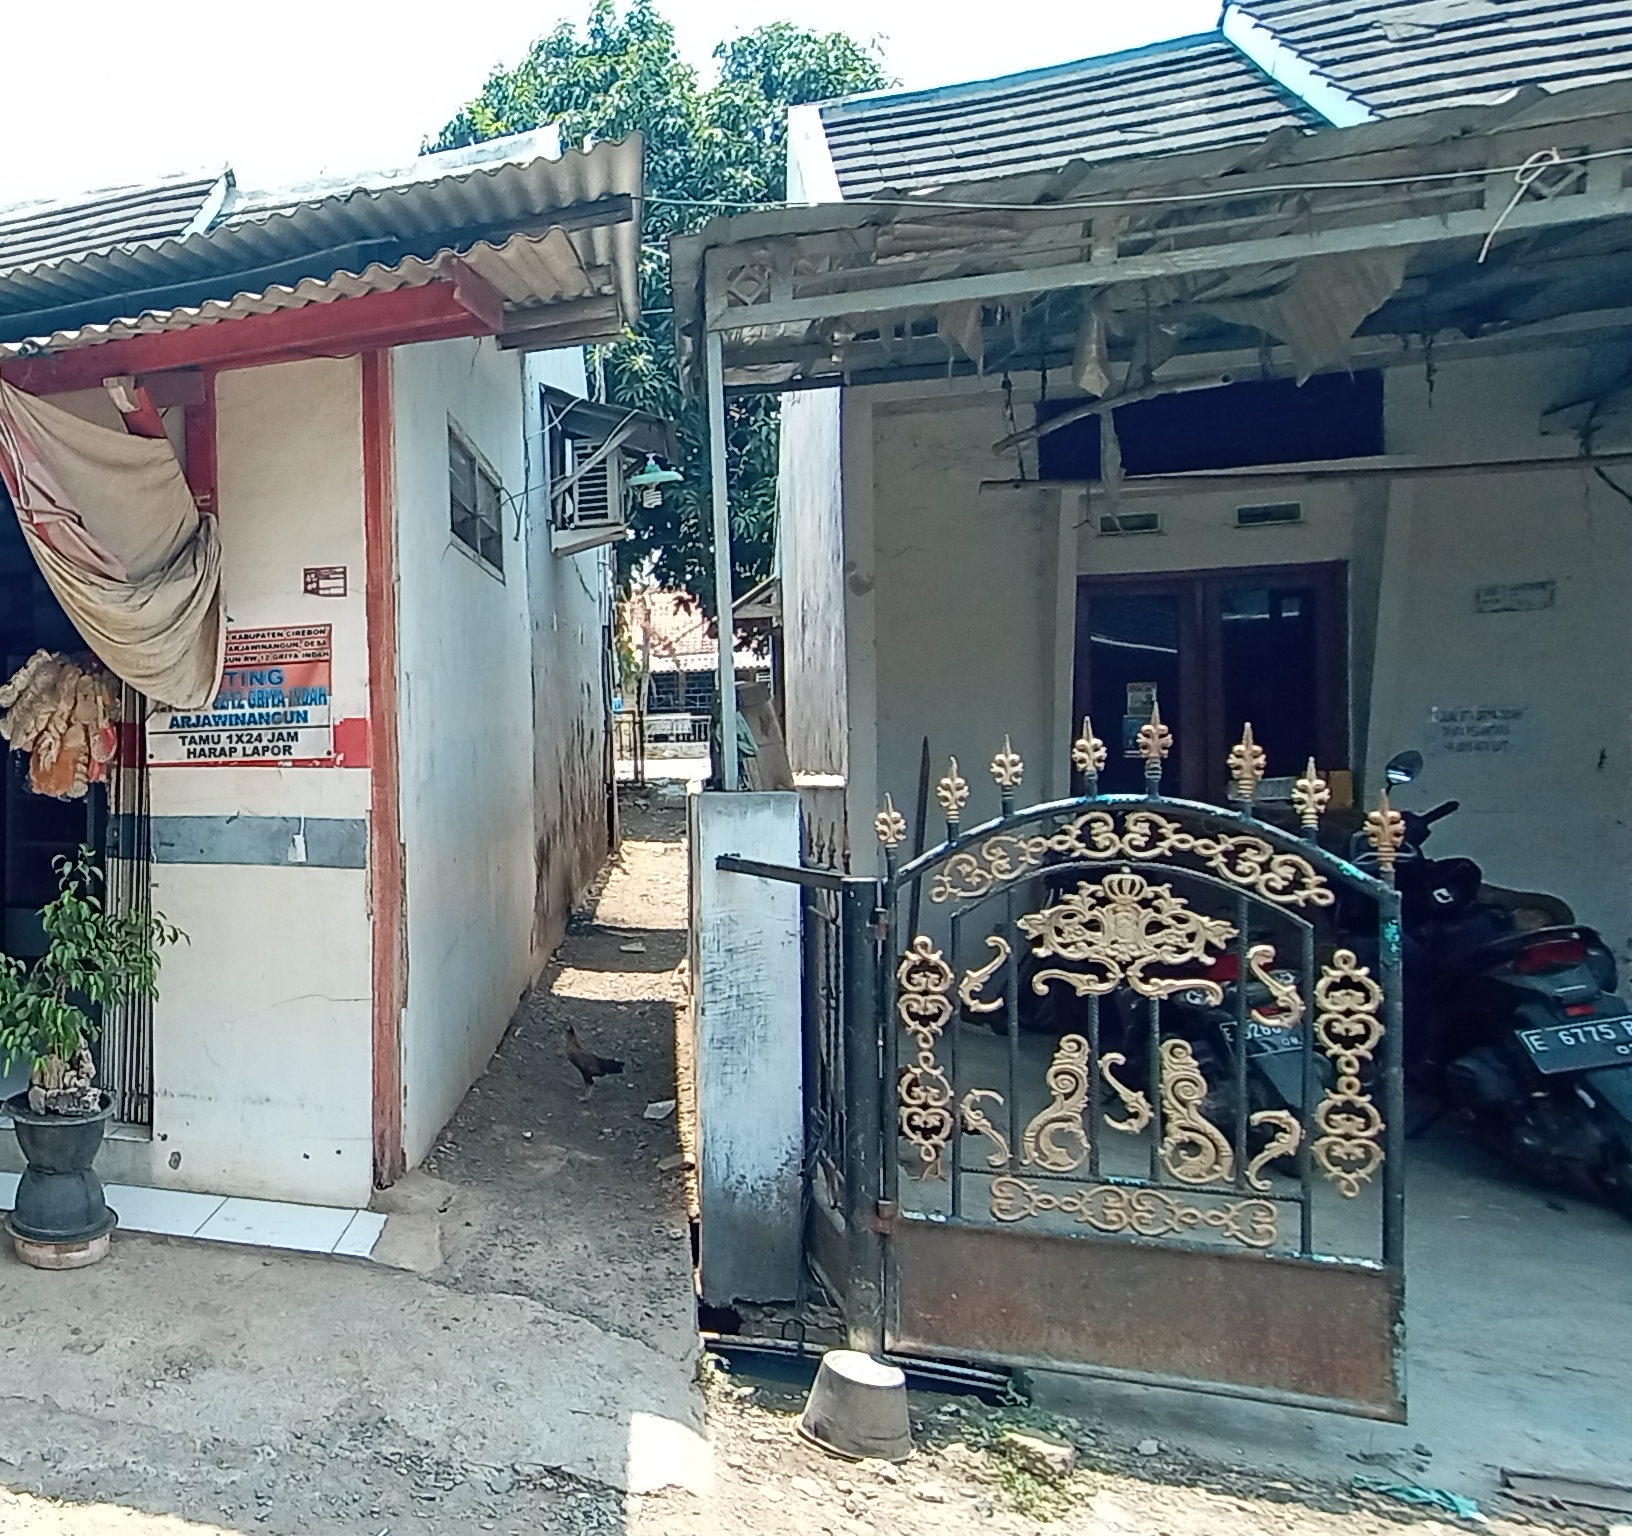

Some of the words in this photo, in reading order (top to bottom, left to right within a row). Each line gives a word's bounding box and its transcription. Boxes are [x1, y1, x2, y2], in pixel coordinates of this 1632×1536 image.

[231, 631, 284, 641] KABUPATEN
[285, 628, 326, 638] CIREBON
[272, 651, 299, 660] GRIYA
[168, 710, 309, 729] ARJAWINANGUN
[179, 733, 221, 746] TAMU
[226, 733, 263, 745] 1X24
[267, 731, 299, 743] JAM
[186, 745, 237, 759] HARAP
[242, 745, 293, 757] LAPOR
[1528, 1034, 1550, 1052] E
[1557, 1023, 1618, 1046] 6775
